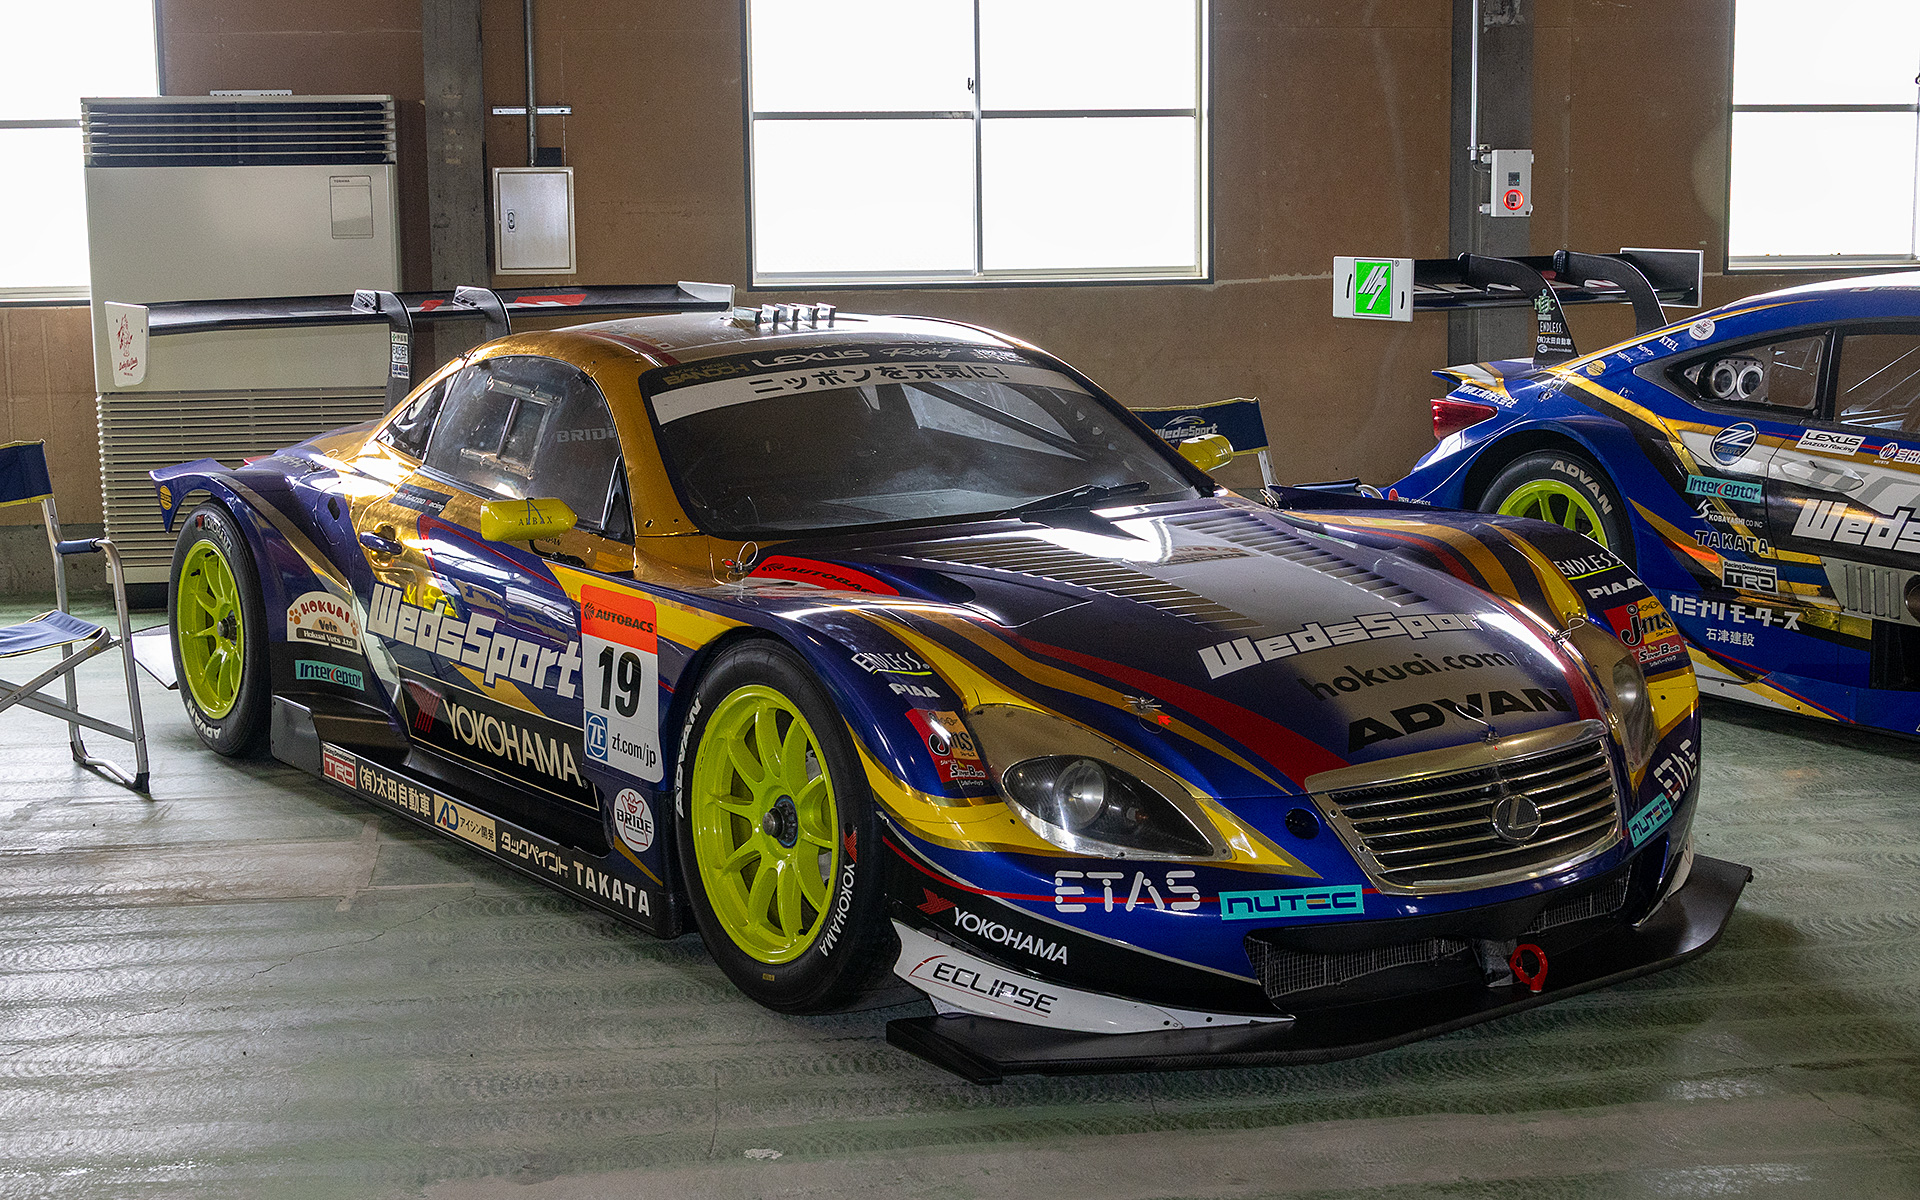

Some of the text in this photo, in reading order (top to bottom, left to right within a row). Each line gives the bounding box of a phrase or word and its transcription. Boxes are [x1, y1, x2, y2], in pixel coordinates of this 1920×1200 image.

[752, 349, 870, 367] LEXUS
[749, 364, 1010, 394] ニッポンを元気に!
[1804, 432, 1862, 446] LEXUS
[1828, 442, 1856, 453] Racing
[1551, 460, 1613, 515] ADVAN
[1689, 477, 1760, 500] Interceptor
[1709, 514, 1745, 525] KOBAYASHI
[1694, 529, 1769, 555] TAKATA
[1553, 552, 1621, 576] ENDLESS
[1741, 563, 1775, 574] Development
[1587, 577, 1643, 599] PIAA
[1726, 571, 1774, 593] TRD
[300, 600, 350, 624] HOKUAI
[595, 608, 654, 634] AUTOBACS
[1620, 604, 1673, 647] jms
[367, 583, 582, 699] WedsSport
[1197, 612, 1484, 680] WedsSpor
[1706, 628, 1755, 647] 石津建設
[300, 662, 362, 688] Interceptor
[851, 651, 921, 673] ENDLESS
[598, 645, 642, 718] 19
[888, 682, 941, 698] PIAA
[187, 698, 222, 740] ADVAN
[1348, 688, 1572, 754] ADVAN
[442, 698, 583, 788] YOKOHAMA
[588, 722, 657, 768] ZF zf.com/jp
[676, 692, 702, 819] ADVAN
[326, 757, 355, 784] TRD
[1653, 738, 1698, 802] ETAS
[360, 764, 431, 818] (有)太田自動車
[459, 816, 495, 844] アイシン開発
[616, 808, 653, 835] BRIDE
[573, 860, 651, 917] TAKATA
[1054, 870, 1201, 913] ETAS
[819, 862, 856, 958] YOKOHAMA
[954, 906, 1068, 966] YOKOHAMA
[932, 962, 1058, 1014] ECLIPSE
